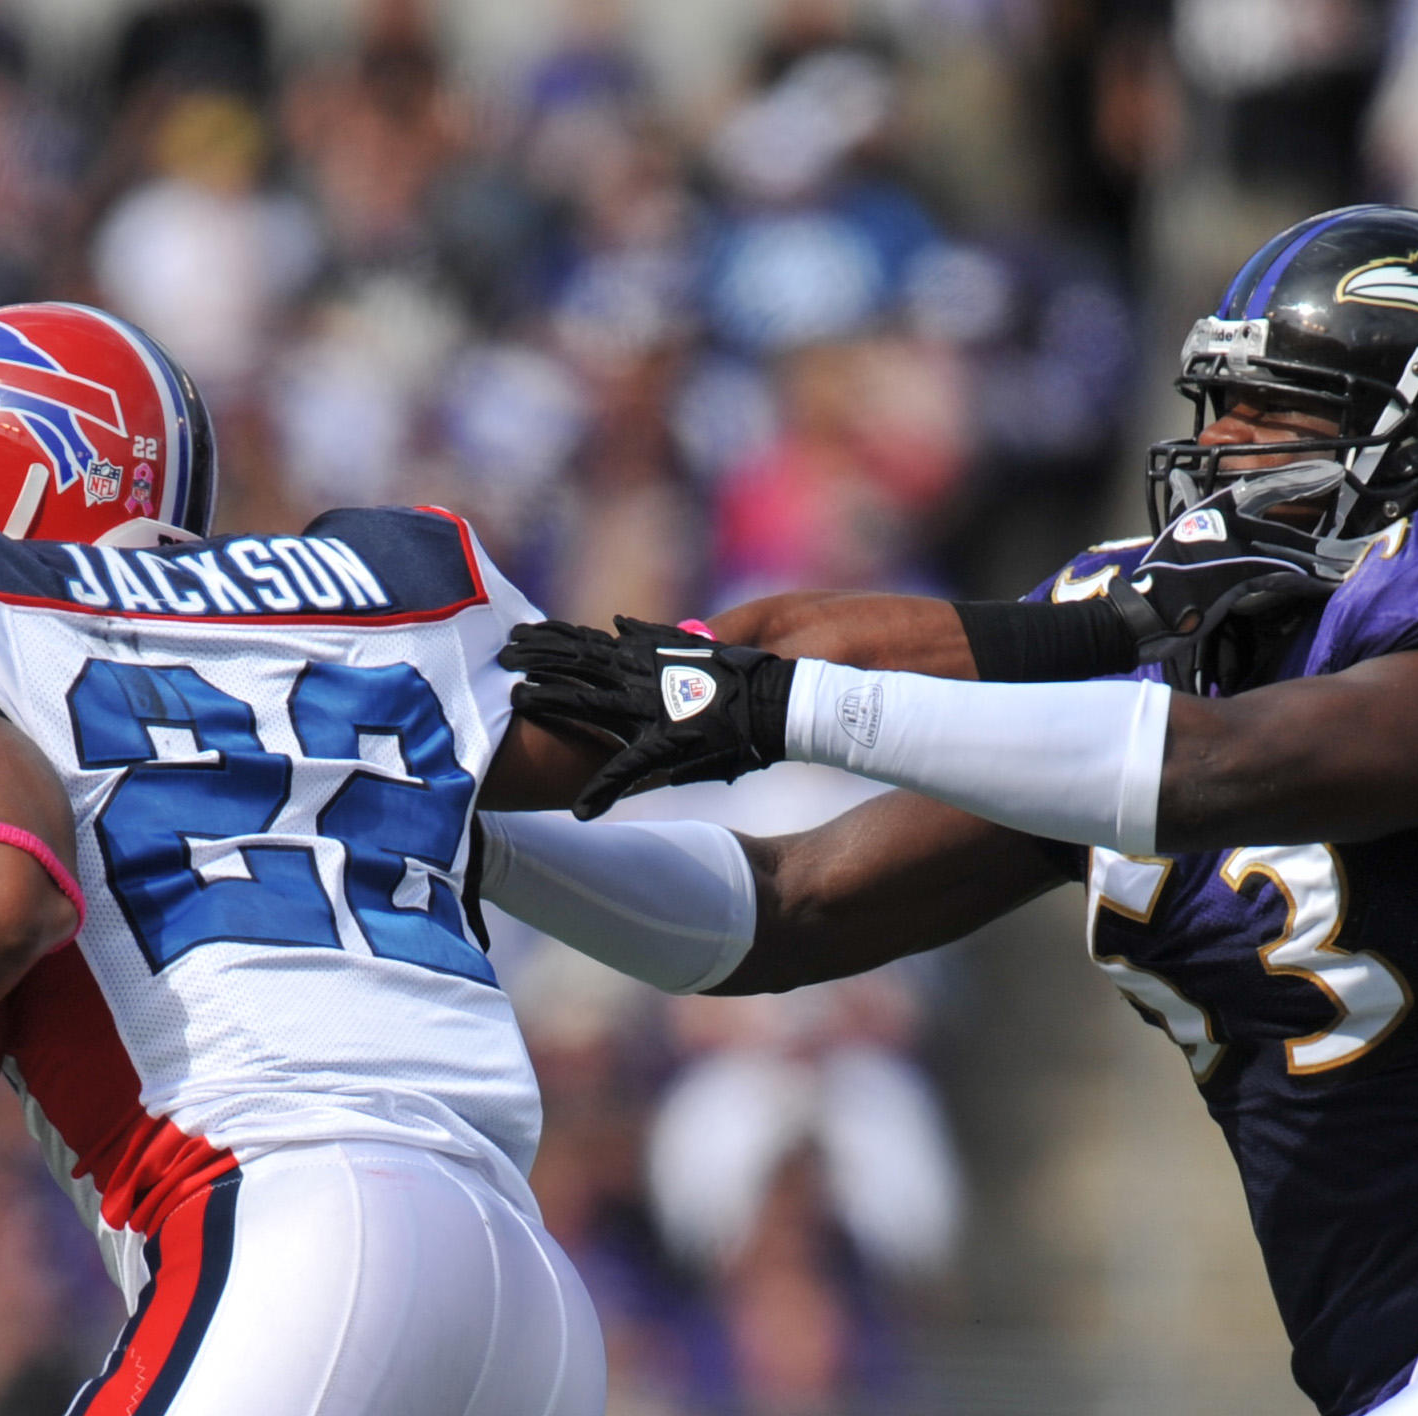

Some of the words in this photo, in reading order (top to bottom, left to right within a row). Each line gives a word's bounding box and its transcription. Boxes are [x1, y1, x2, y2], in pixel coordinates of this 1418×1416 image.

[132, 434, 158, 461] 22
[90, 475, 117, 497] NFL
[61, 536, 392, 615] JACKSON
[842, 696, 860, 724] NFL
[865, 686, 881, 744] EQUIPMENT
[65, 656, 501, 978] 22
[1085, 842, 1415, 1086] 53
